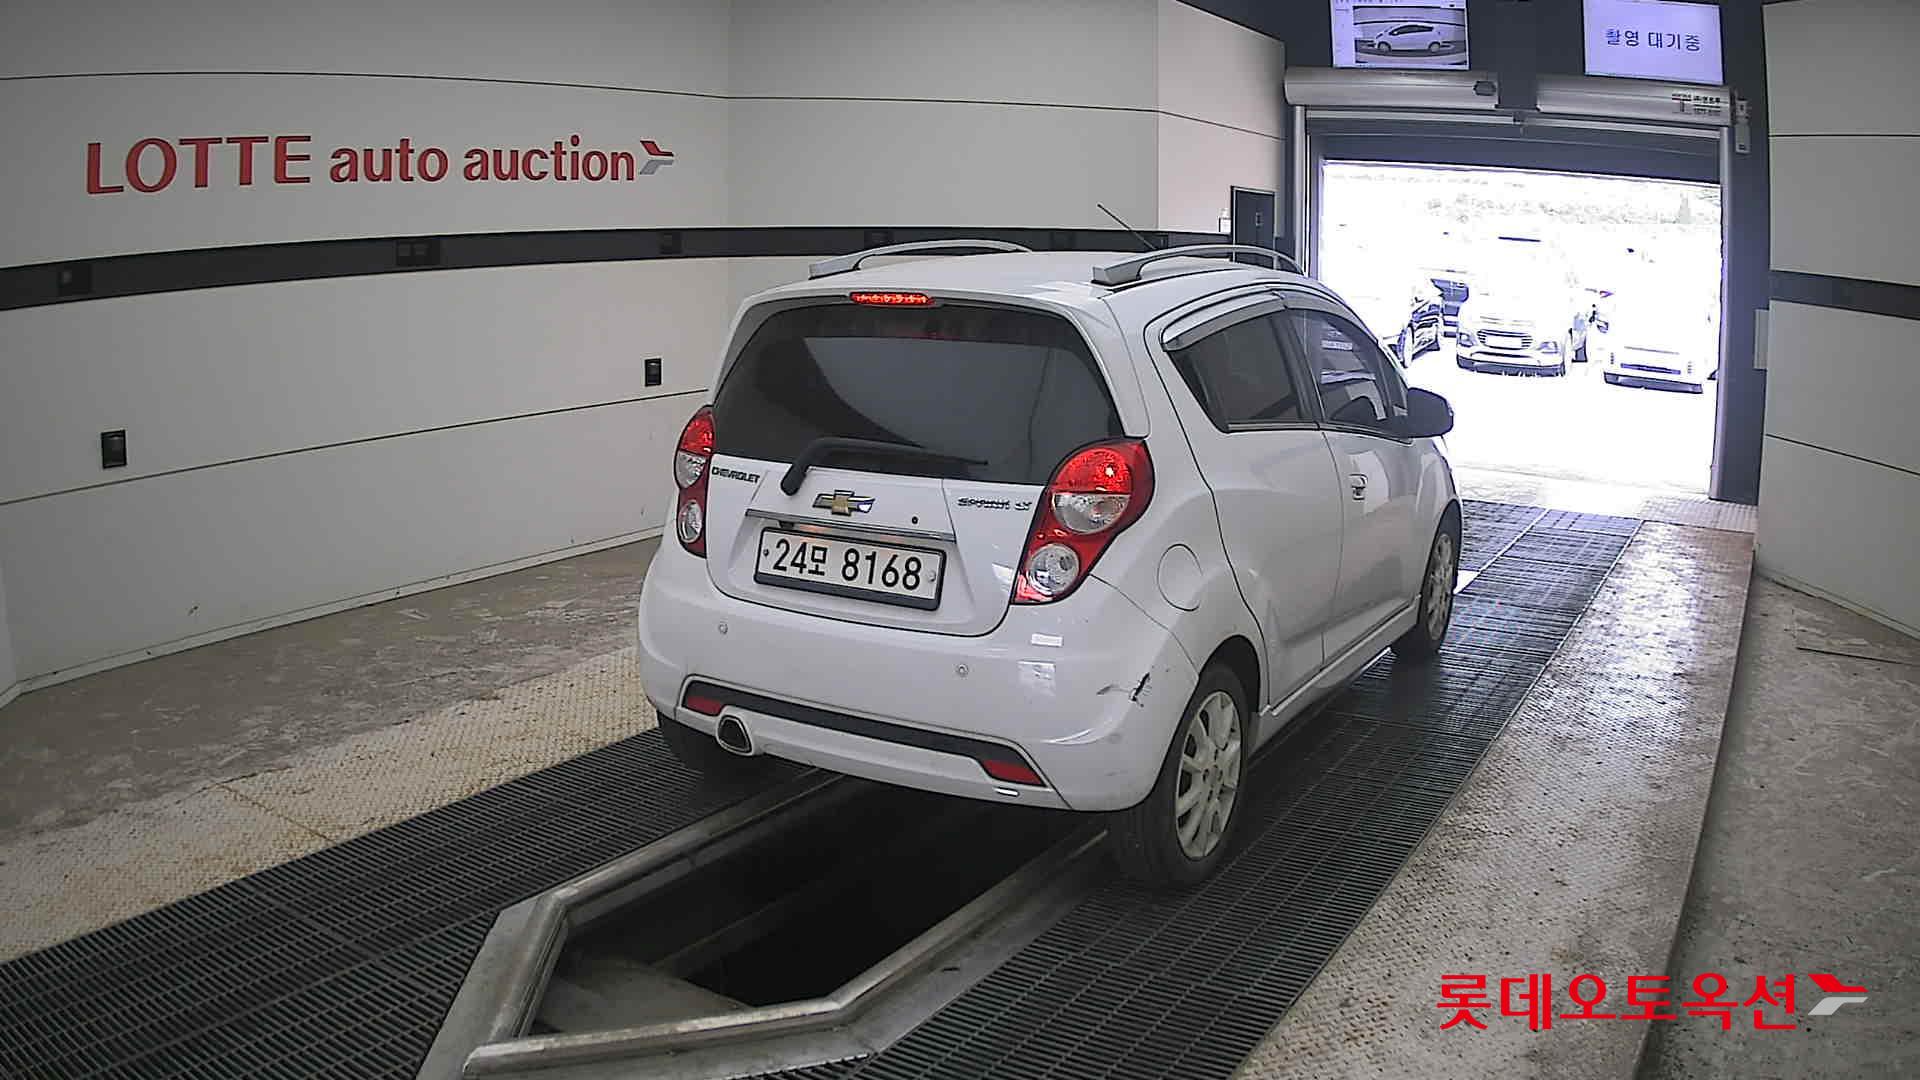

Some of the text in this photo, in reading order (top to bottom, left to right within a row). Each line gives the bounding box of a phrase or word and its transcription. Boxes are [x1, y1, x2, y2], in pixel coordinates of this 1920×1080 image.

[1647, 31, 1701, 52] 대기중
[86, 134, 635, 194] LOTTE auto auction
[773, 538, 922, 590] 24모 8168
